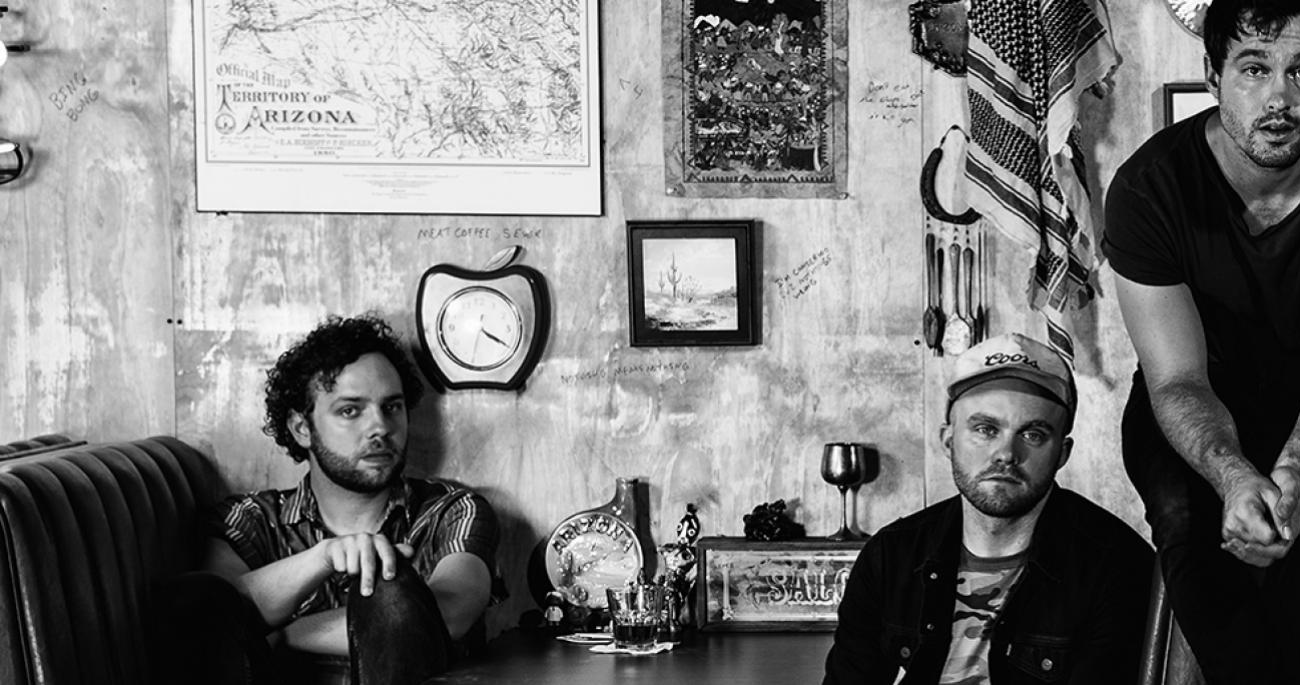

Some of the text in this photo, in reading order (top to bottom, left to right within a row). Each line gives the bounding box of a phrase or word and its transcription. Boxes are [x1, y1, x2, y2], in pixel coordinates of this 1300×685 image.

[215, 63, 291, 89] Official Map
[216, 83, 310, 112] TERRITORY
[238, 105, 358, 135] ARIZONA
[985, 352, 1041, 371] Coors
